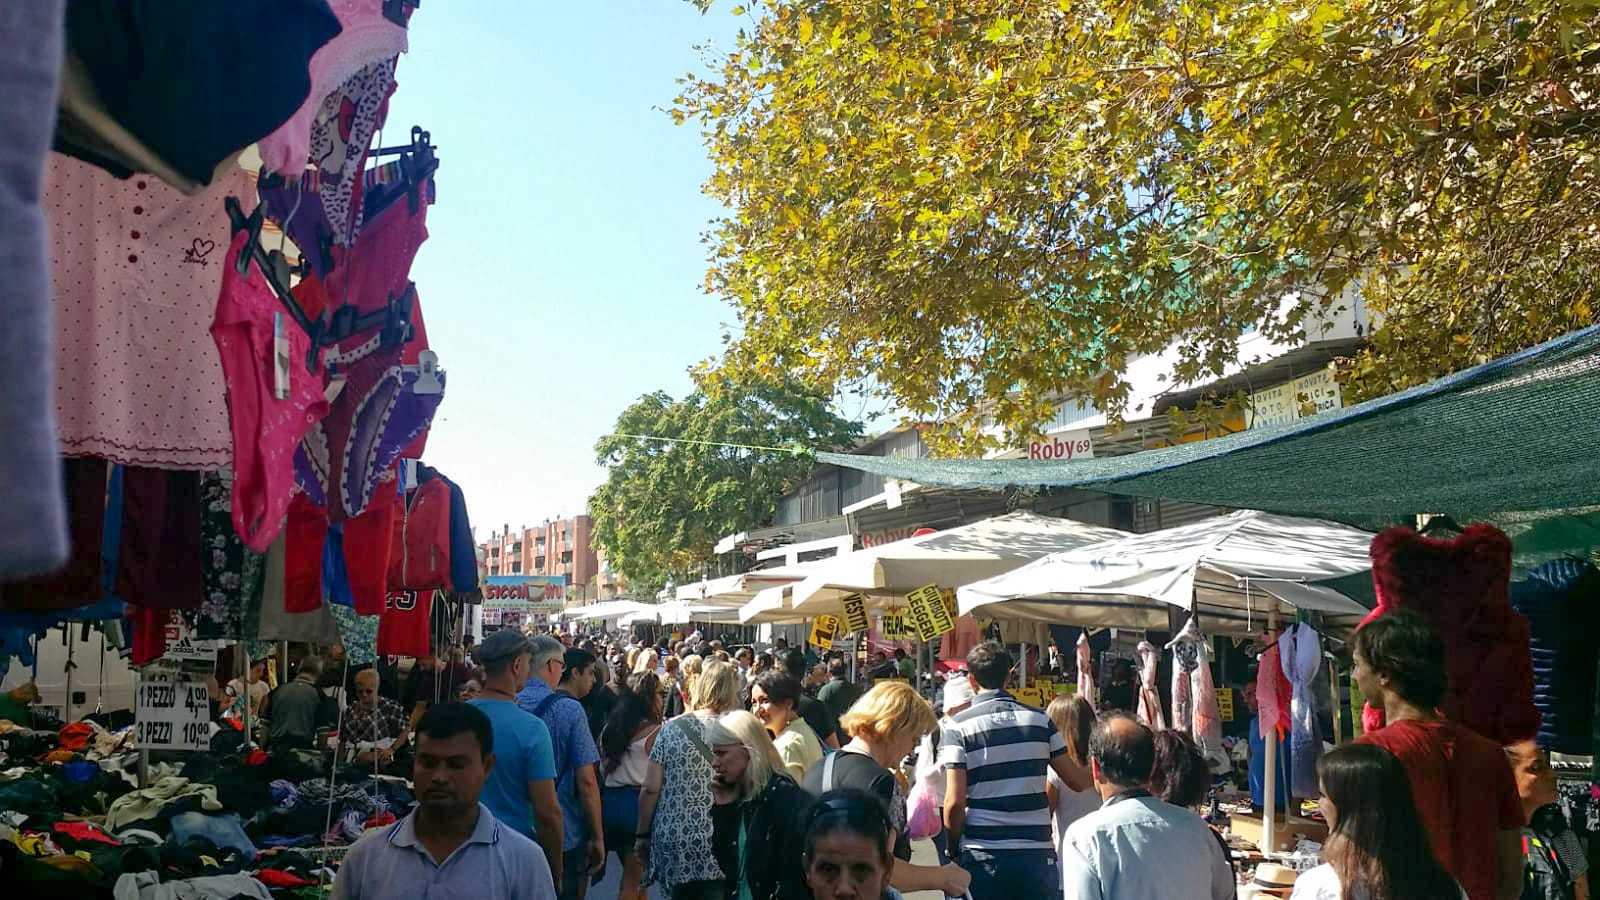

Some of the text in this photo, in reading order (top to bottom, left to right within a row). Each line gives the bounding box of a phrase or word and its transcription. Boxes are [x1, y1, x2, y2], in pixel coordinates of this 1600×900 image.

[1030, 437, 1090, 460] Roby 69
[906, 591, 937, 640] LEGGERI
[146, 686, 177, 709] PEZZO
[137, 721, 144, 744] 3
[145, 721, 174, 745] PEZZI
